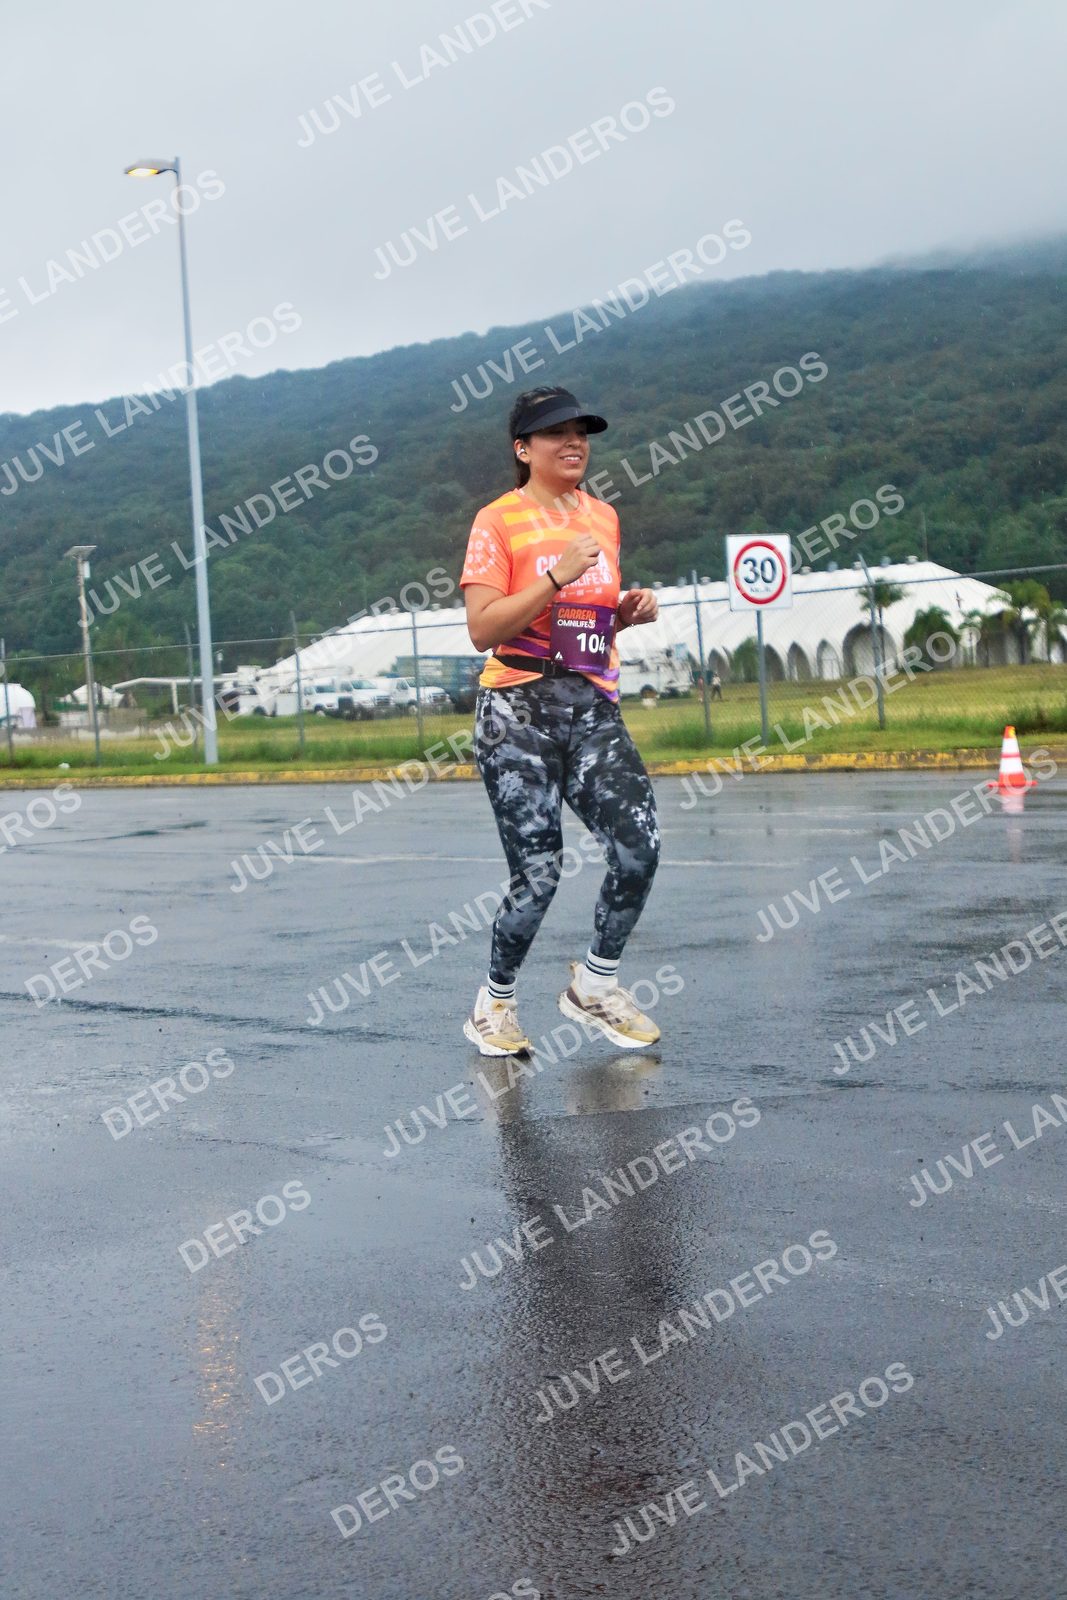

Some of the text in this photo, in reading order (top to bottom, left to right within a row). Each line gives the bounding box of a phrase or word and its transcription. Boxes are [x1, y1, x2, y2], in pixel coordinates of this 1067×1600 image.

[743, 557, 777, 583] 30
[558, 608, 596, 620] CARRERA
[557, 619, 589, 628] OMNILIFE
